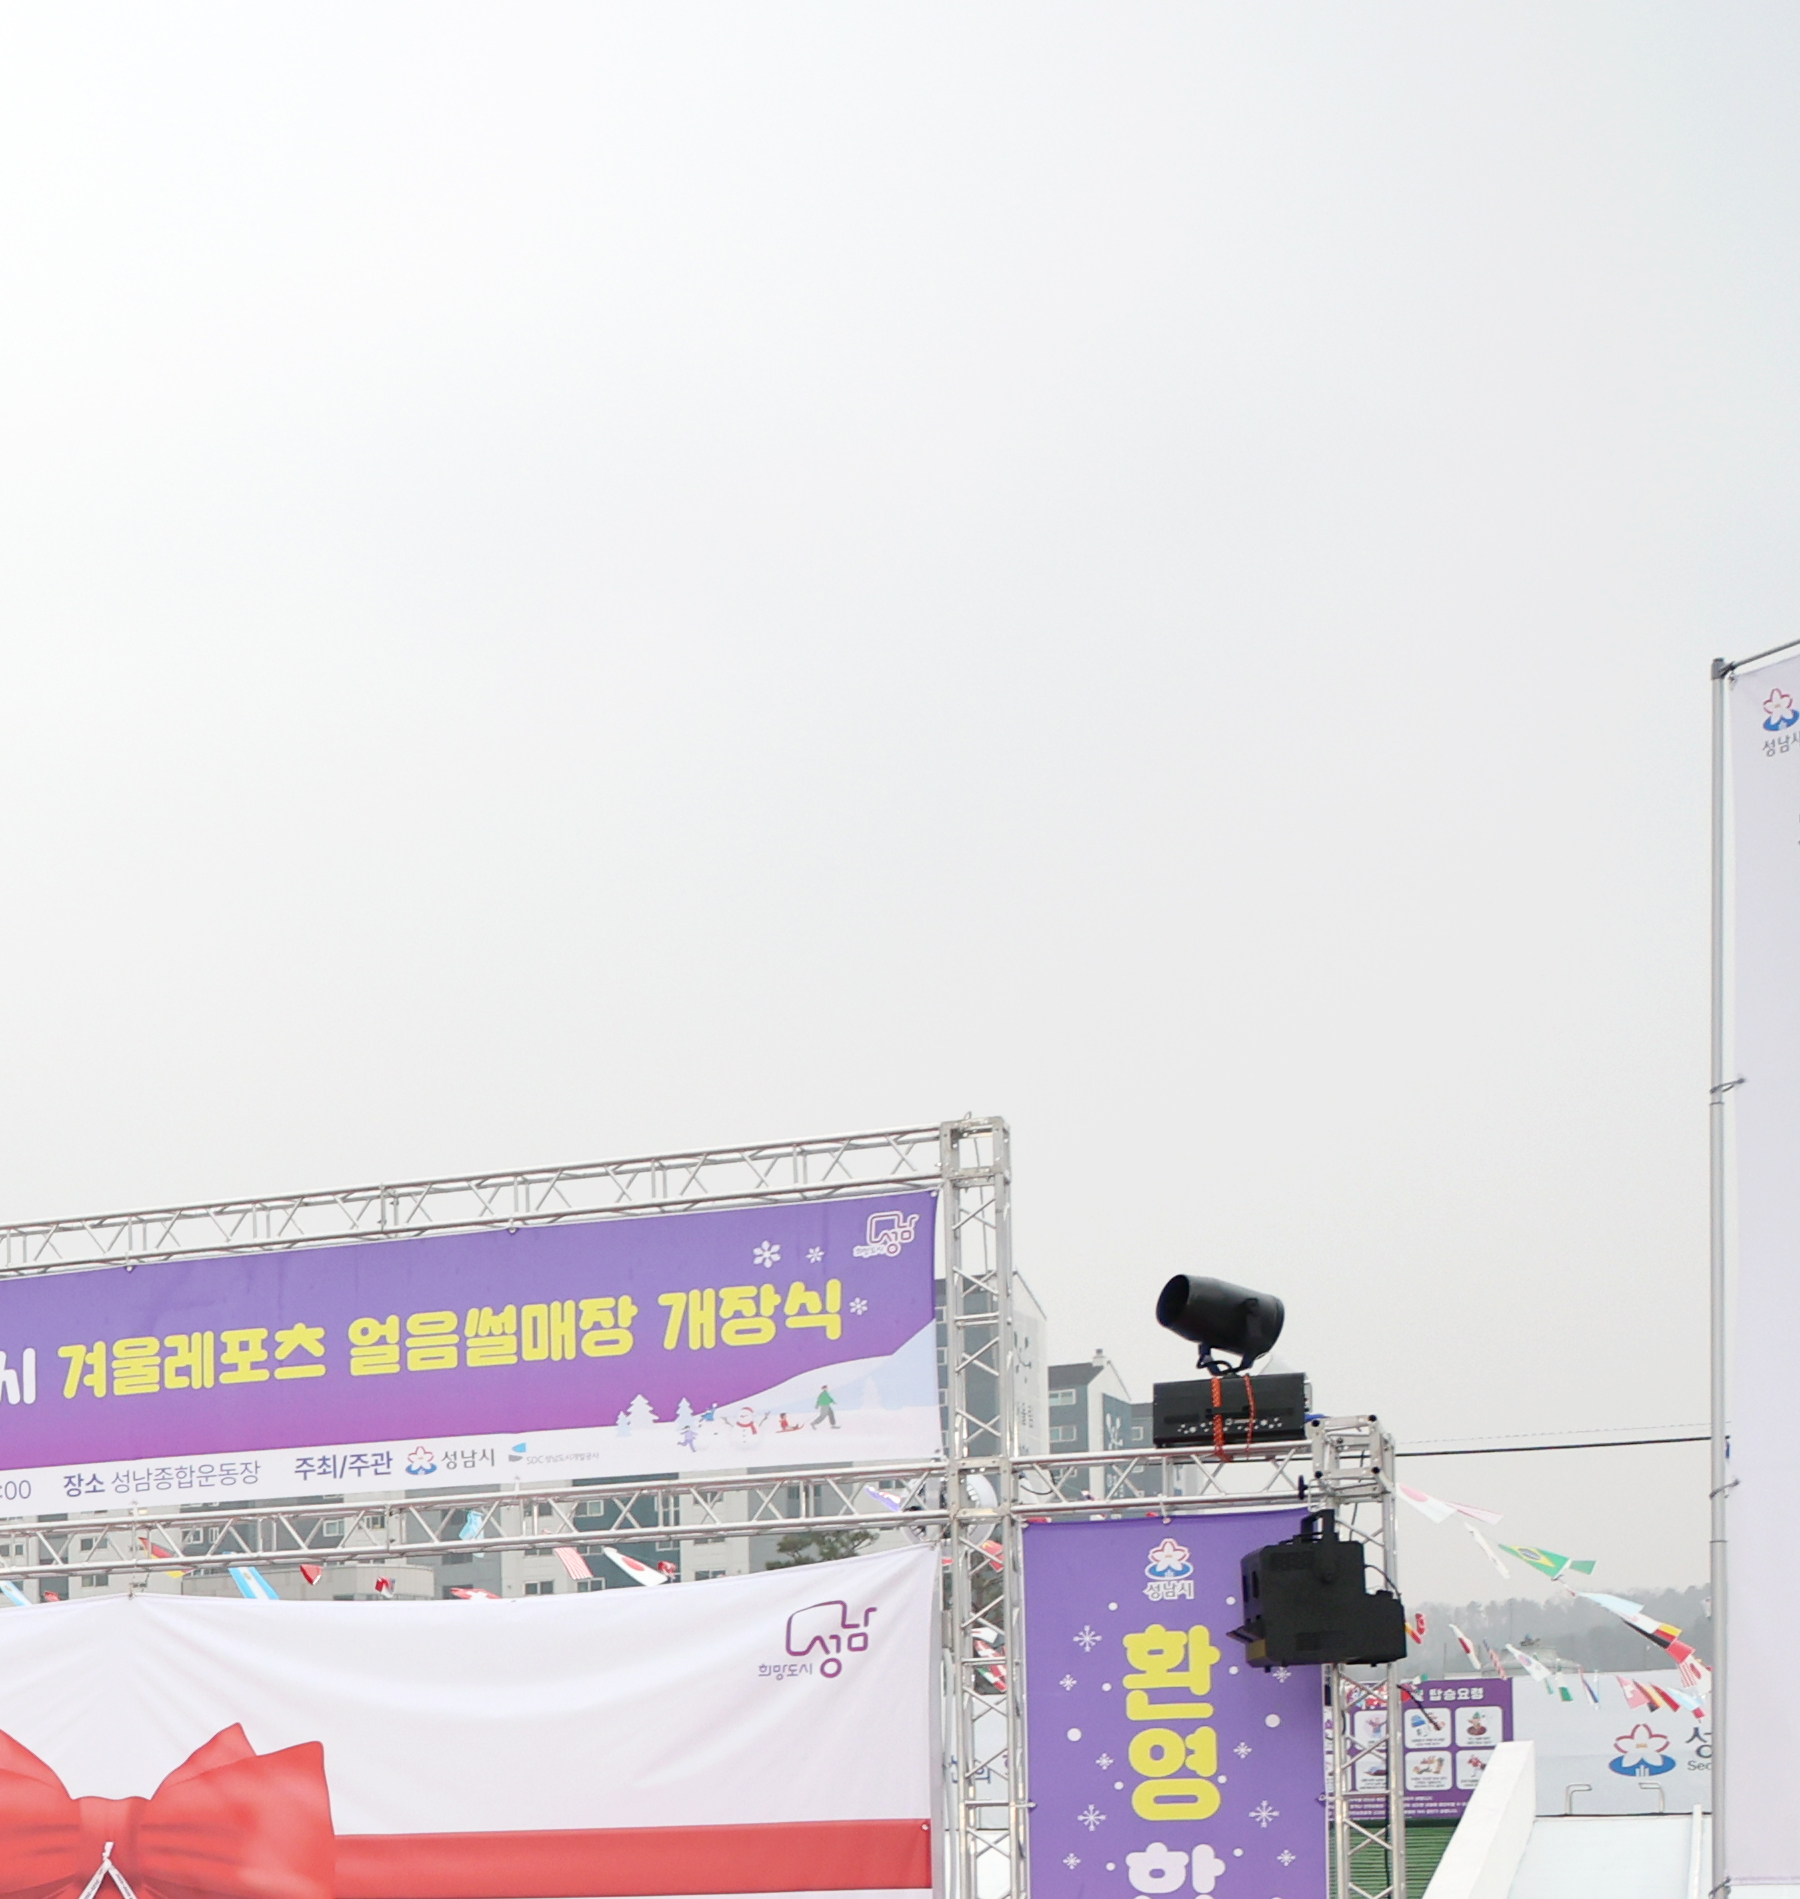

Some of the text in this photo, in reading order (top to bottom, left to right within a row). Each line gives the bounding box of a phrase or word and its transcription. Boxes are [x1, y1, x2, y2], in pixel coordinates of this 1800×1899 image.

[57, 1323, 327, 1399] 겨울레포츠
[348, 1294, 639, 1377] 얼음썰매장
[658, 1278, 842, 1352] 개장식
[63, 1473, 105, 1496] 장소
[110, 1460, 261, 1495] 성남종합운동장
[294, 1451, 394, 1481] 주최/주관
[441, 1448, 496, 1470] 성남시
[1143, 1580, 1194, 1602] 성남시
[758, 1663, 813, 1681] 희망도시
